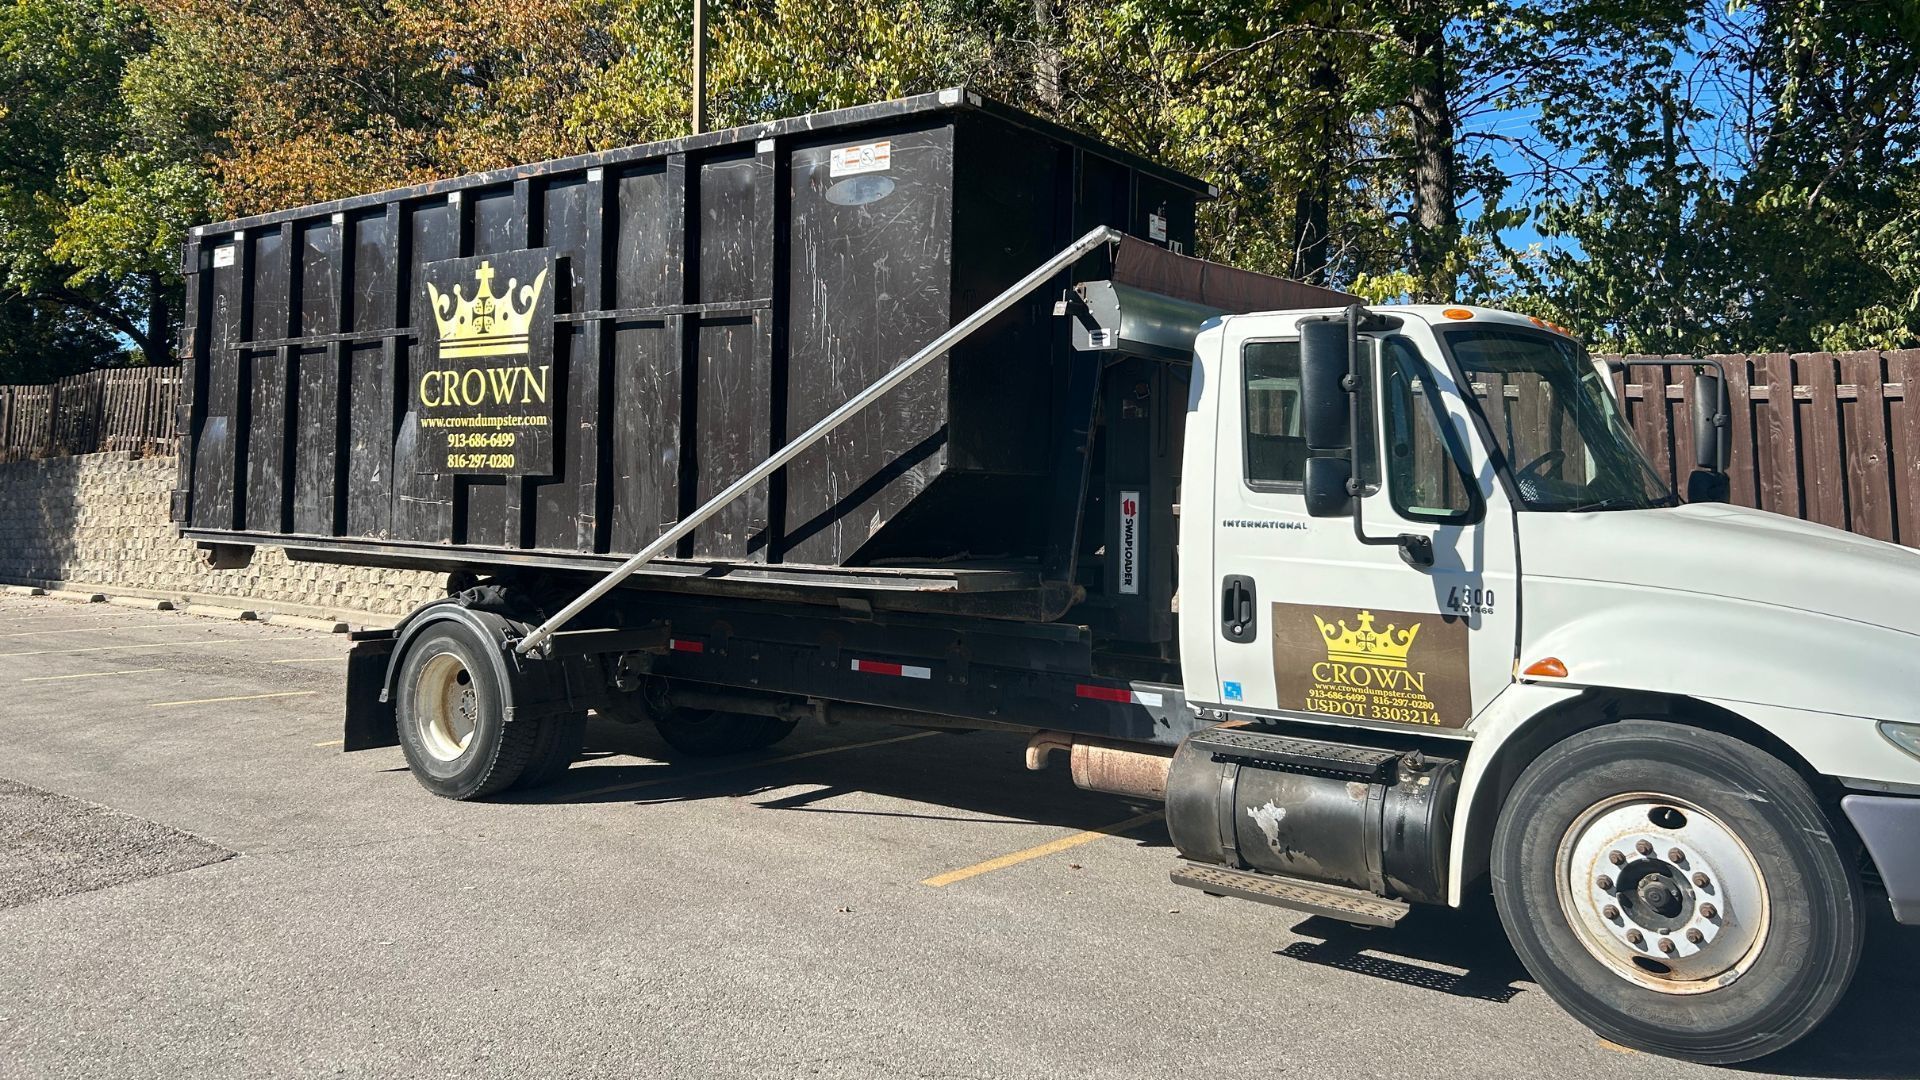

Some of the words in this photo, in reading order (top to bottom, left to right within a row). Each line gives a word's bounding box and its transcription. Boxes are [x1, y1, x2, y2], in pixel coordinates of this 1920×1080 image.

[420, 366, 549, 407] CROWN
[421, 413, 547, 430] www.crowndumpster.com
[447, 432, 515, 448] 913-686-6499
[447, 453, 515, 468] 816-297-0280
[1222, 519, 1308, 530] INTERNATIONAL
[1124, 518, 1134, 586] SWAPLOADER
[1447, 586, 1495, 612] 4300
[1462, 605, 1494, 615] DT466
[1312, 662, 1425, 693] CROWN
[1309, 689, 1366, 702] 913-686-6499
[1373, 696, 1435, 710] 816-297-0280
[1315, 682, 1427, 700] www.crowndumpster.com
[1305, 698, 1367, 717] USDOT
[1371, 705, 1441, 726] 3303214
